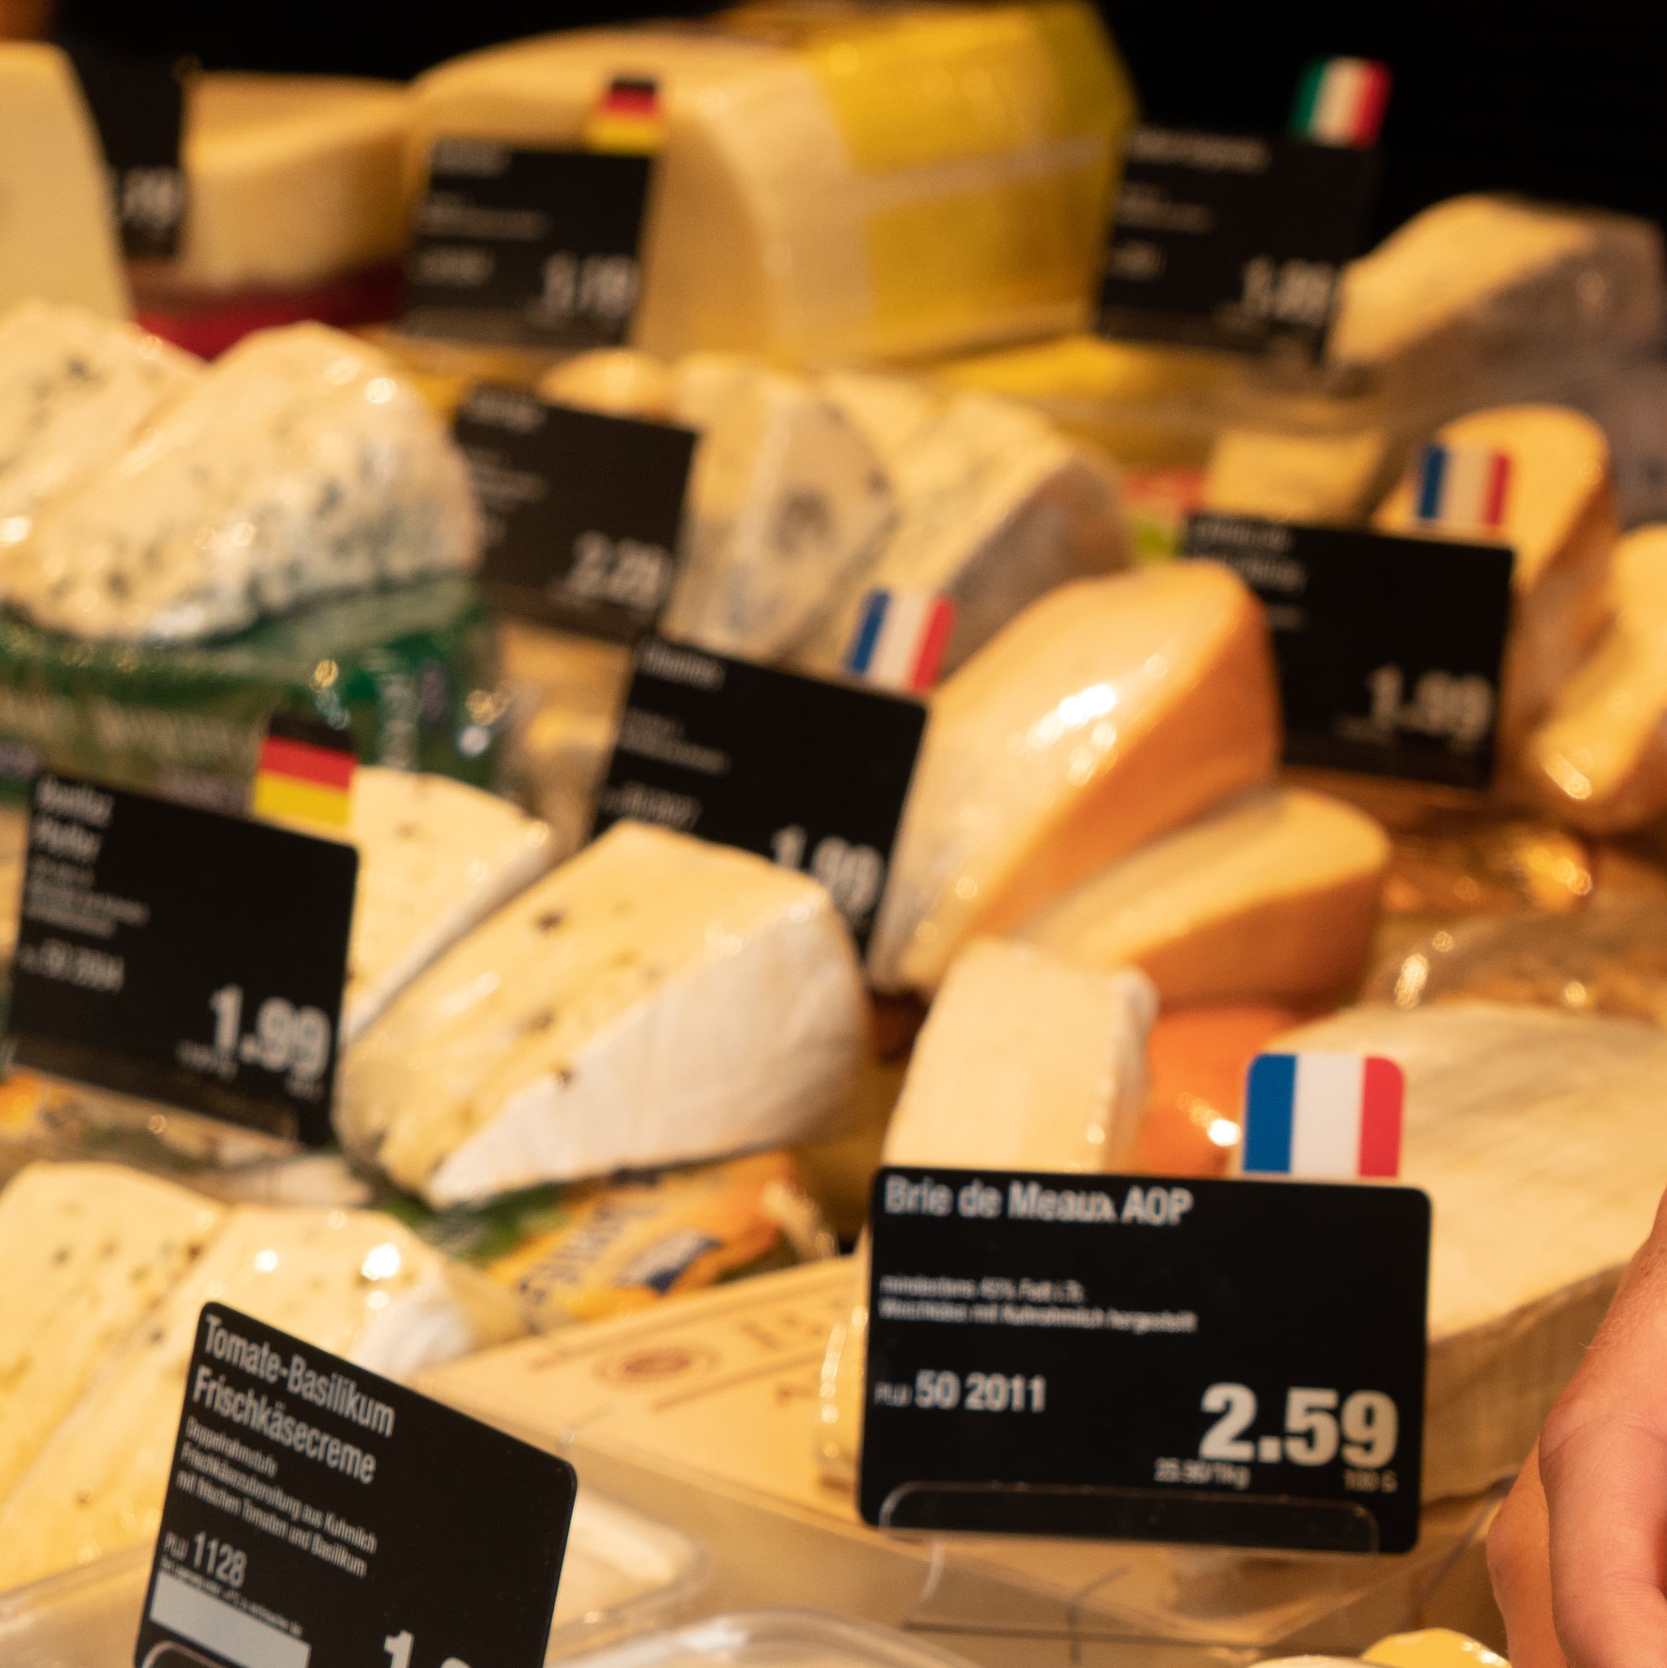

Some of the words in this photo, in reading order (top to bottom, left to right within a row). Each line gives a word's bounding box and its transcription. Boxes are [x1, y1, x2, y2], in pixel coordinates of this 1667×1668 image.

[209, 983, 332, 1081] 1.99
[884, 1174, 954, 1217] Brie
[957, 1177, 1003, 1219] de
[1007, 1179, 1119, 1223] Meaux
[1119, 1185, 1195, 1226] AOP
[205, 1313, 396, 1438] Tomate-Basilikum
[875, 1381, 914, 1407] PLU
[914, 1368, 961, 1411] 50
[964, 1371, 1048, 1414] 2011
[193, 1365, 377, 1485] Frischkäsecreme
[1199, 1380, 1399, 1469] 2.59
[1343, 1469, 1381, 1493] 100
[164, 1531, 189, 1561] PLU
[193, 1531, 248, 1589] 1128
[175, 1470, 197, 1493] mit
[241, 1497, 289, 1539] Tomaten
[287, 1525, 313, 1550] und
[310, 1534, 368, 1579] Basilikum
[302, 1503, 325, 1528] aus
[324, 1511, 378, 1555] Kuhmilch
